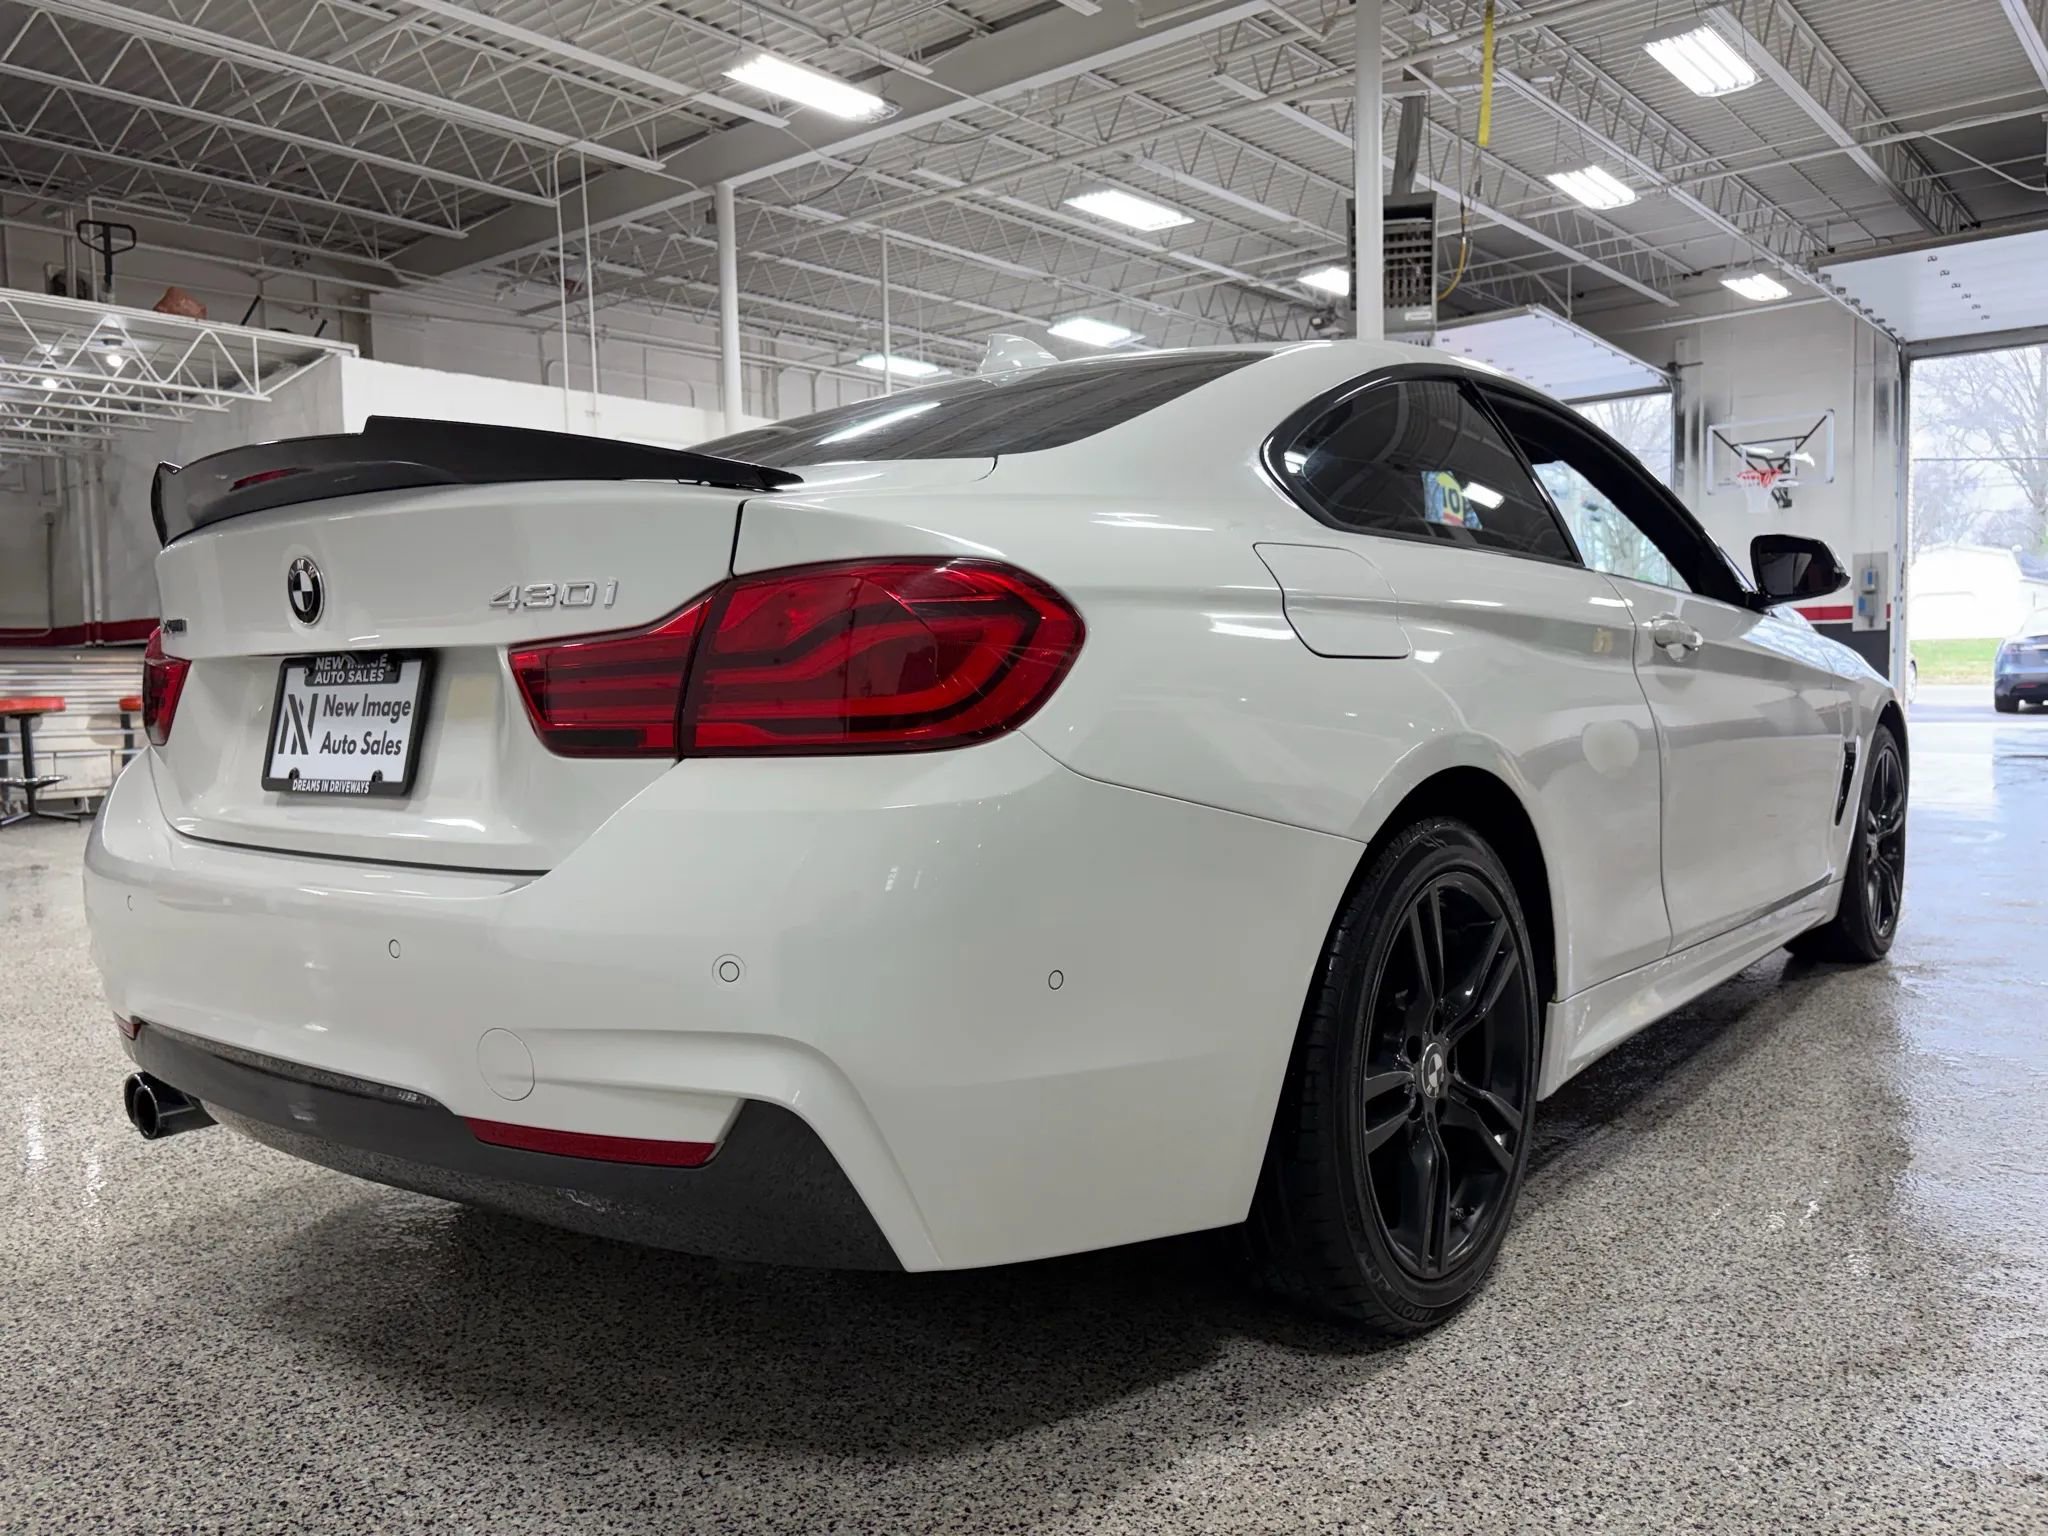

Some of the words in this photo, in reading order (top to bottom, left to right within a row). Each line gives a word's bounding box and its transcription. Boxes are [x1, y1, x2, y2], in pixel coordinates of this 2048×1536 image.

[489, 576, 619, 610] 430i
[315, 656, 345, 671] NEW
[314, 671, 346, 684] AUTO
[347, 668, 385, 683] SALES
[323, 694, 359, 717] New
[361, 693, 411, 724] Image
[319, 731, 357, 755] Auto
[360, 730, 402, 756] Sales
[292, 779, 320, 793] DREAMS
[320, 780, 329, 792] IN
[329, 780, 370, 794] DRIVEWAYS
